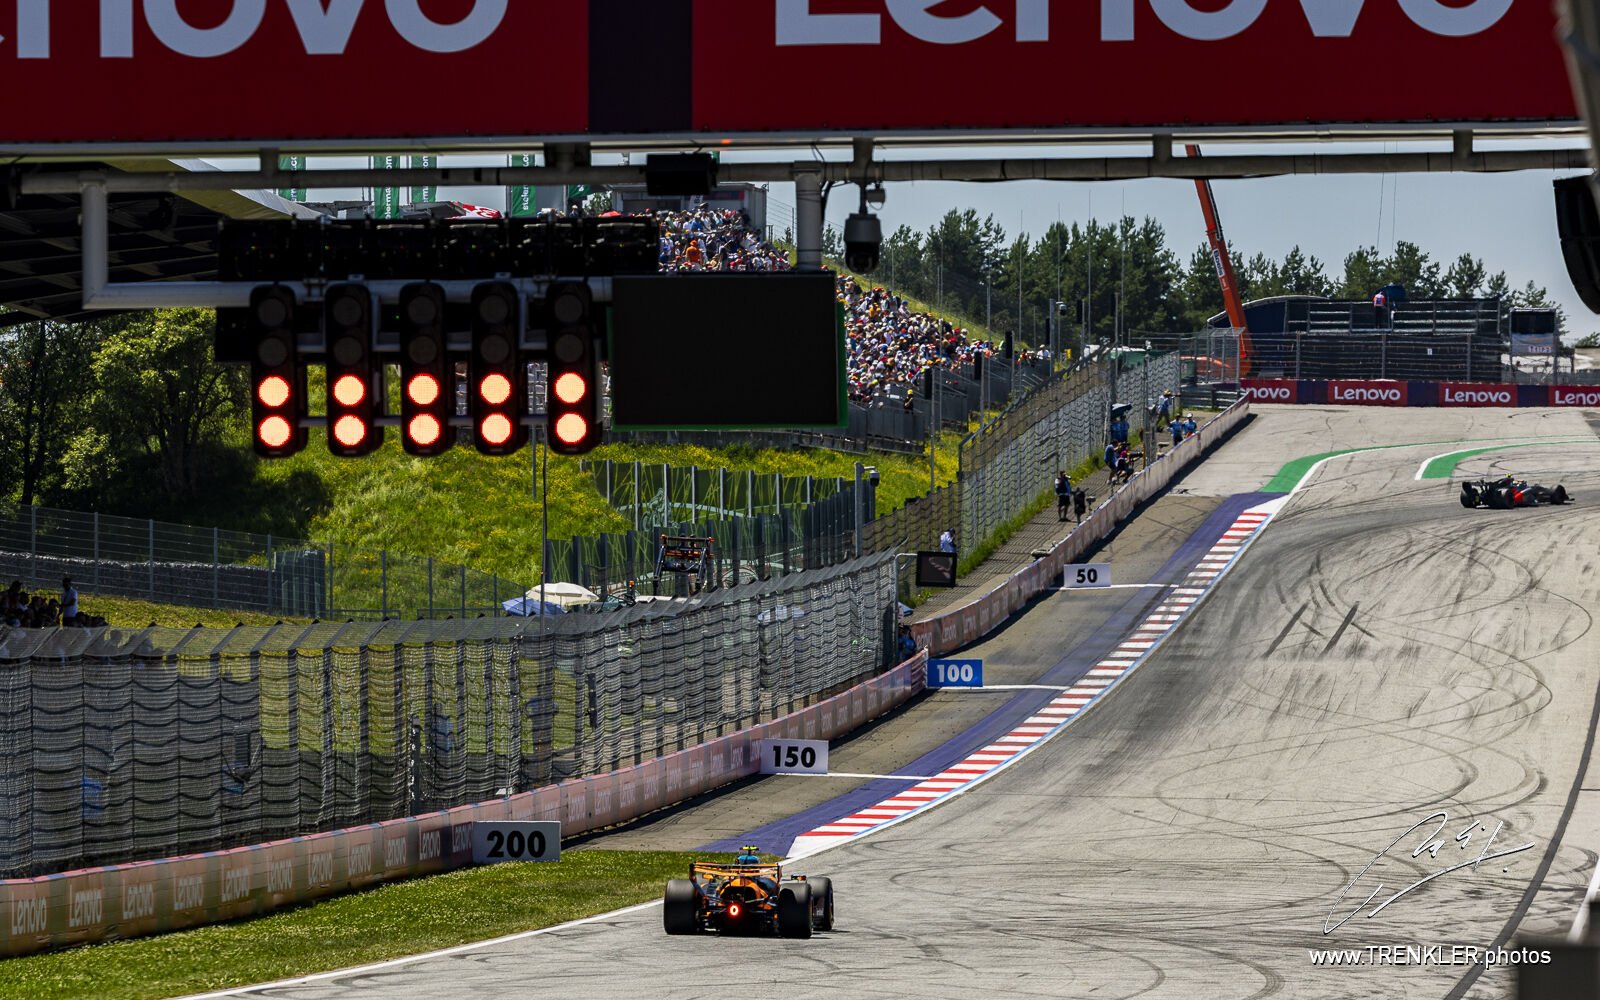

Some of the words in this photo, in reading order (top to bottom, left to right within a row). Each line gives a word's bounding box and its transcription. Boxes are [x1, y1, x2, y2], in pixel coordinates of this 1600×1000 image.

[1334, 386, 1401, 400] Lenovo
[1444, 388, 1511, 403] Lenovo
[1076, 568, 1098, 583] 50
[936, 664, 974, 683] 100
[772, 745, 817, 768] 150
[419, 827, 441, 861] Lenovo
[487, 830, 546, 858] 200
[11, 890, 48, 936] Lenovo
[69, 884, 103, 928] Lenovo
